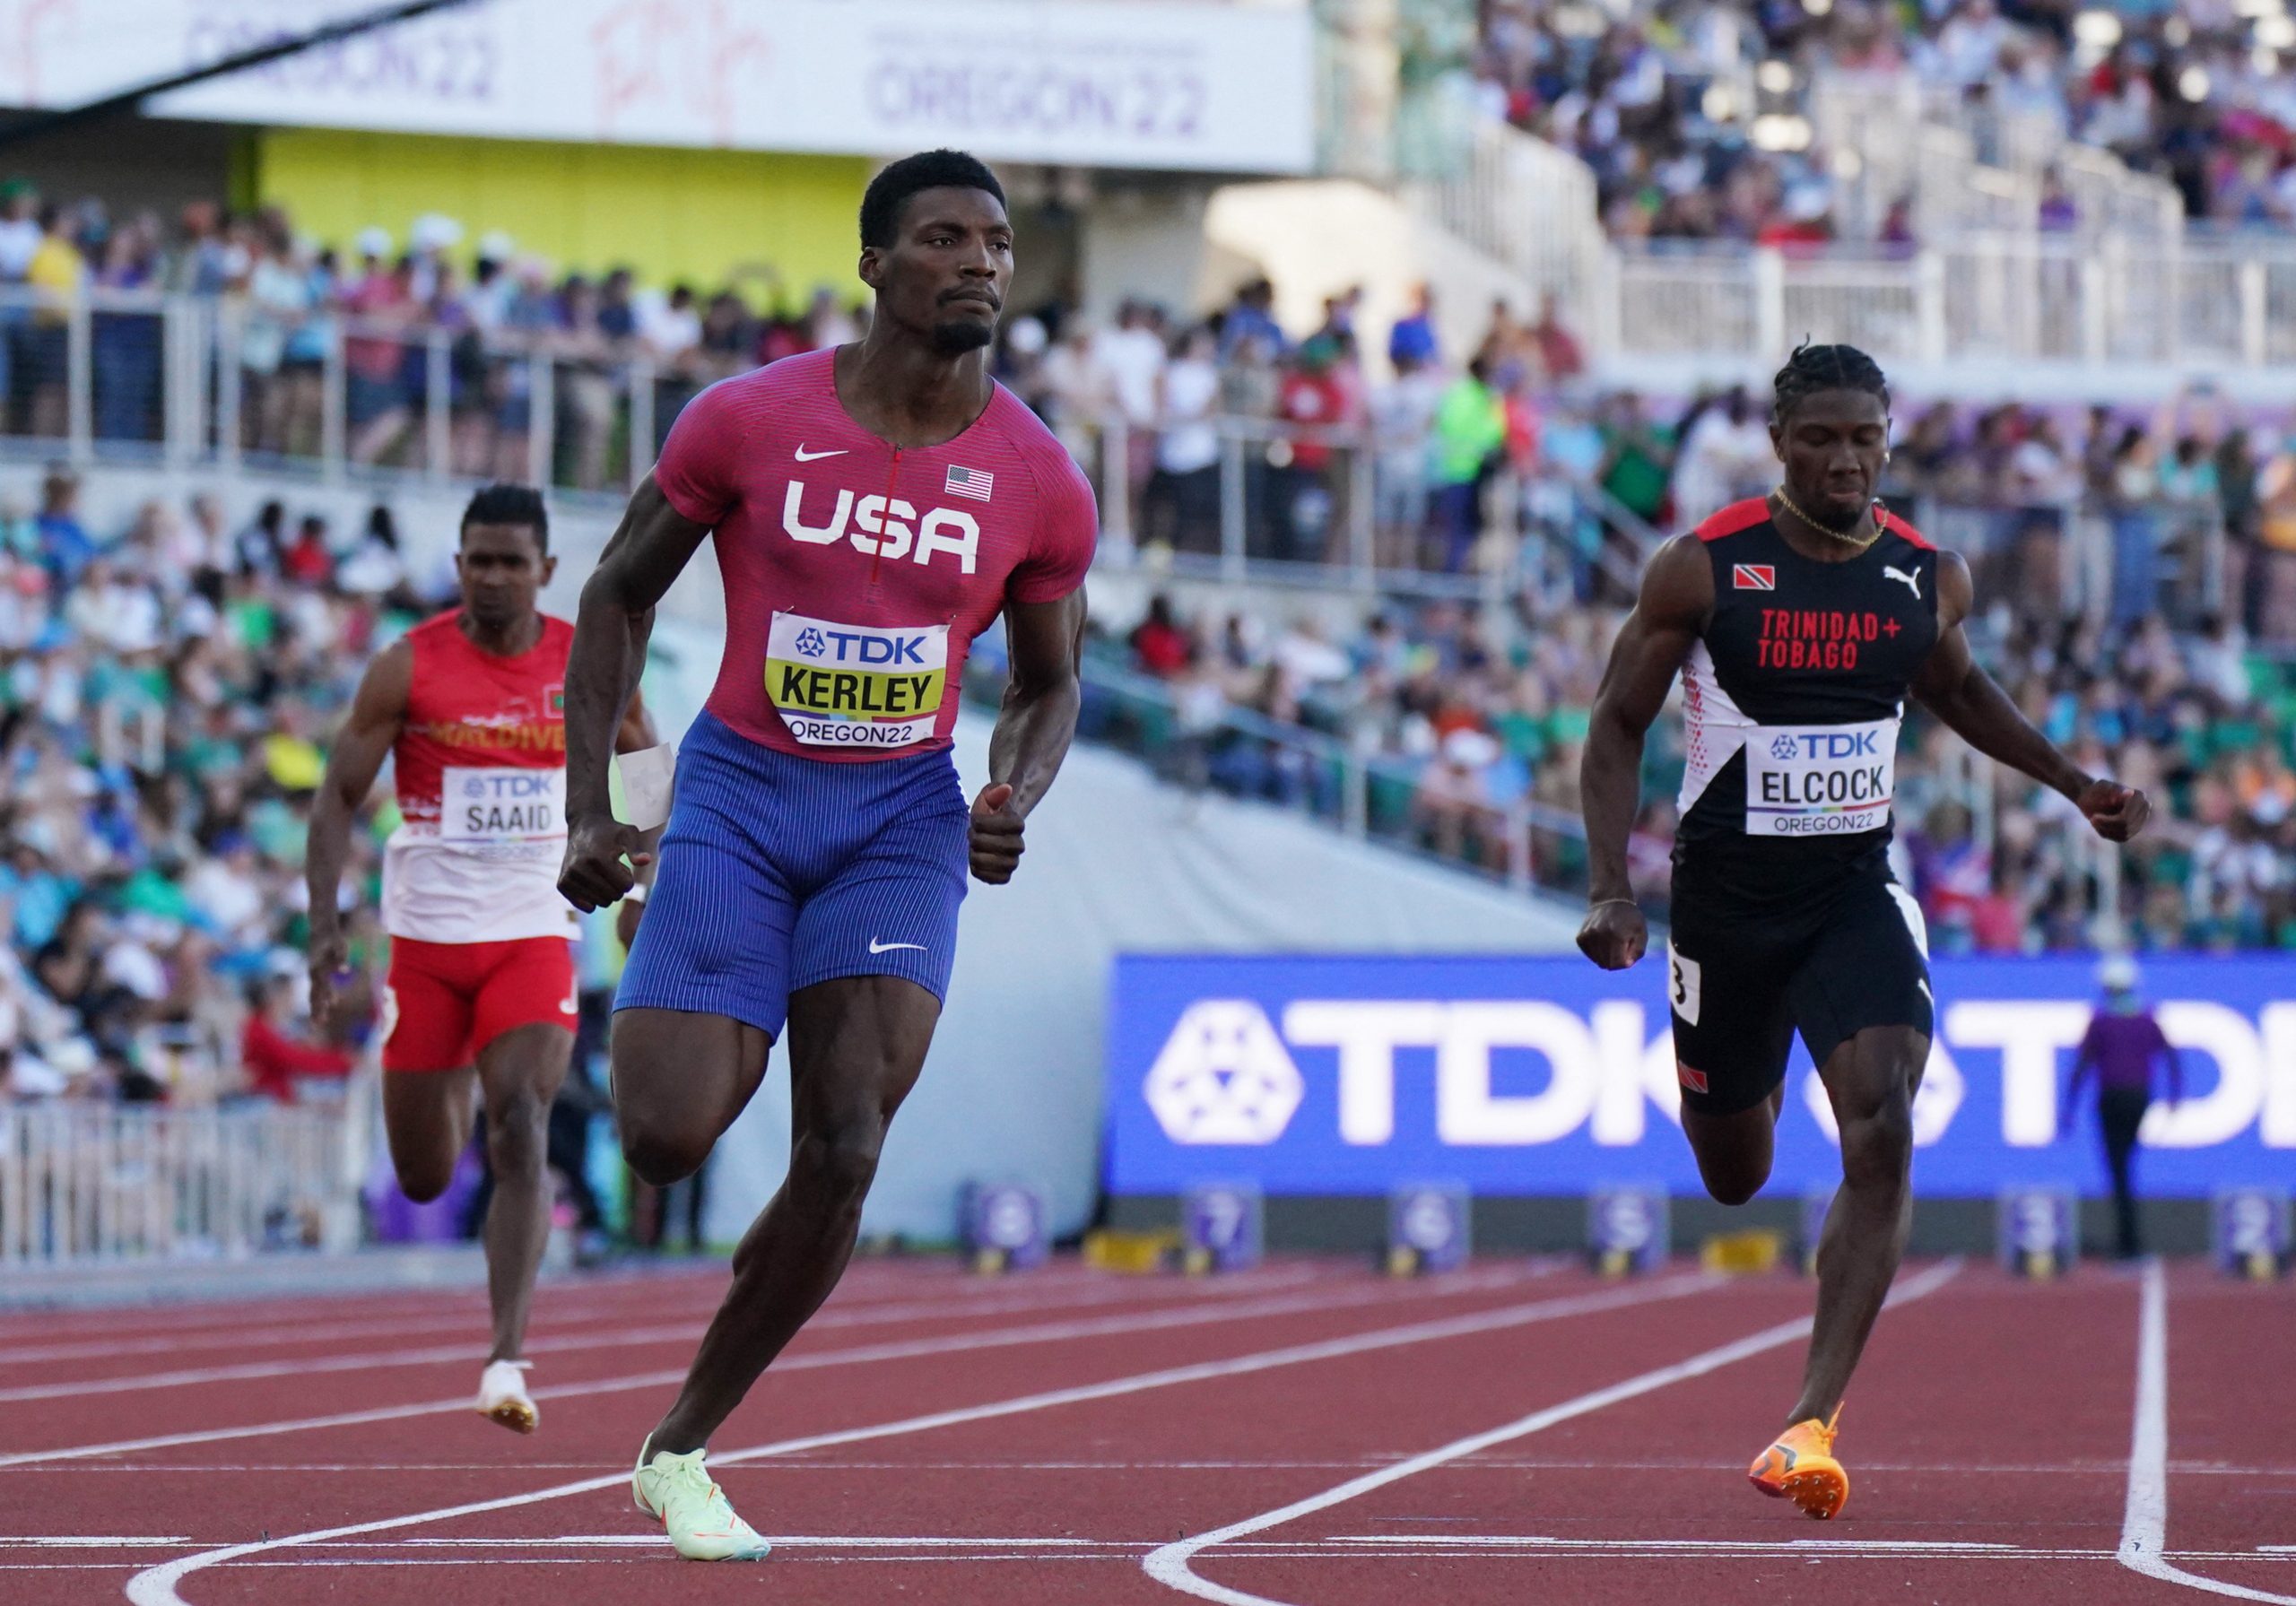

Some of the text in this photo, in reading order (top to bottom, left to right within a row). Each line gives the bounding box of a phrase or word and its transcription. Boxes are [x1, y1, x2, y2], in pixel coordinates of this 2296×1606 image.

[782, 480, 979, 574] USA
[826, 630, 927, 664] TDK
[1758, 639, 1858, 669] TOBAGO
[780, 665, 933, 712] KERLEY
[789, 720, 913, 743] OREGON22
[1798, 729, 1878, 759] TDK
[487, 776, 552, 798] TDK
[1761, 766, 1885, 804] ELCOCK
[466, 804, 552, 833] SAAID
[1774, 812, 1874, 832] OREGON22
[1206, 1191, 1241, 1245] 7
